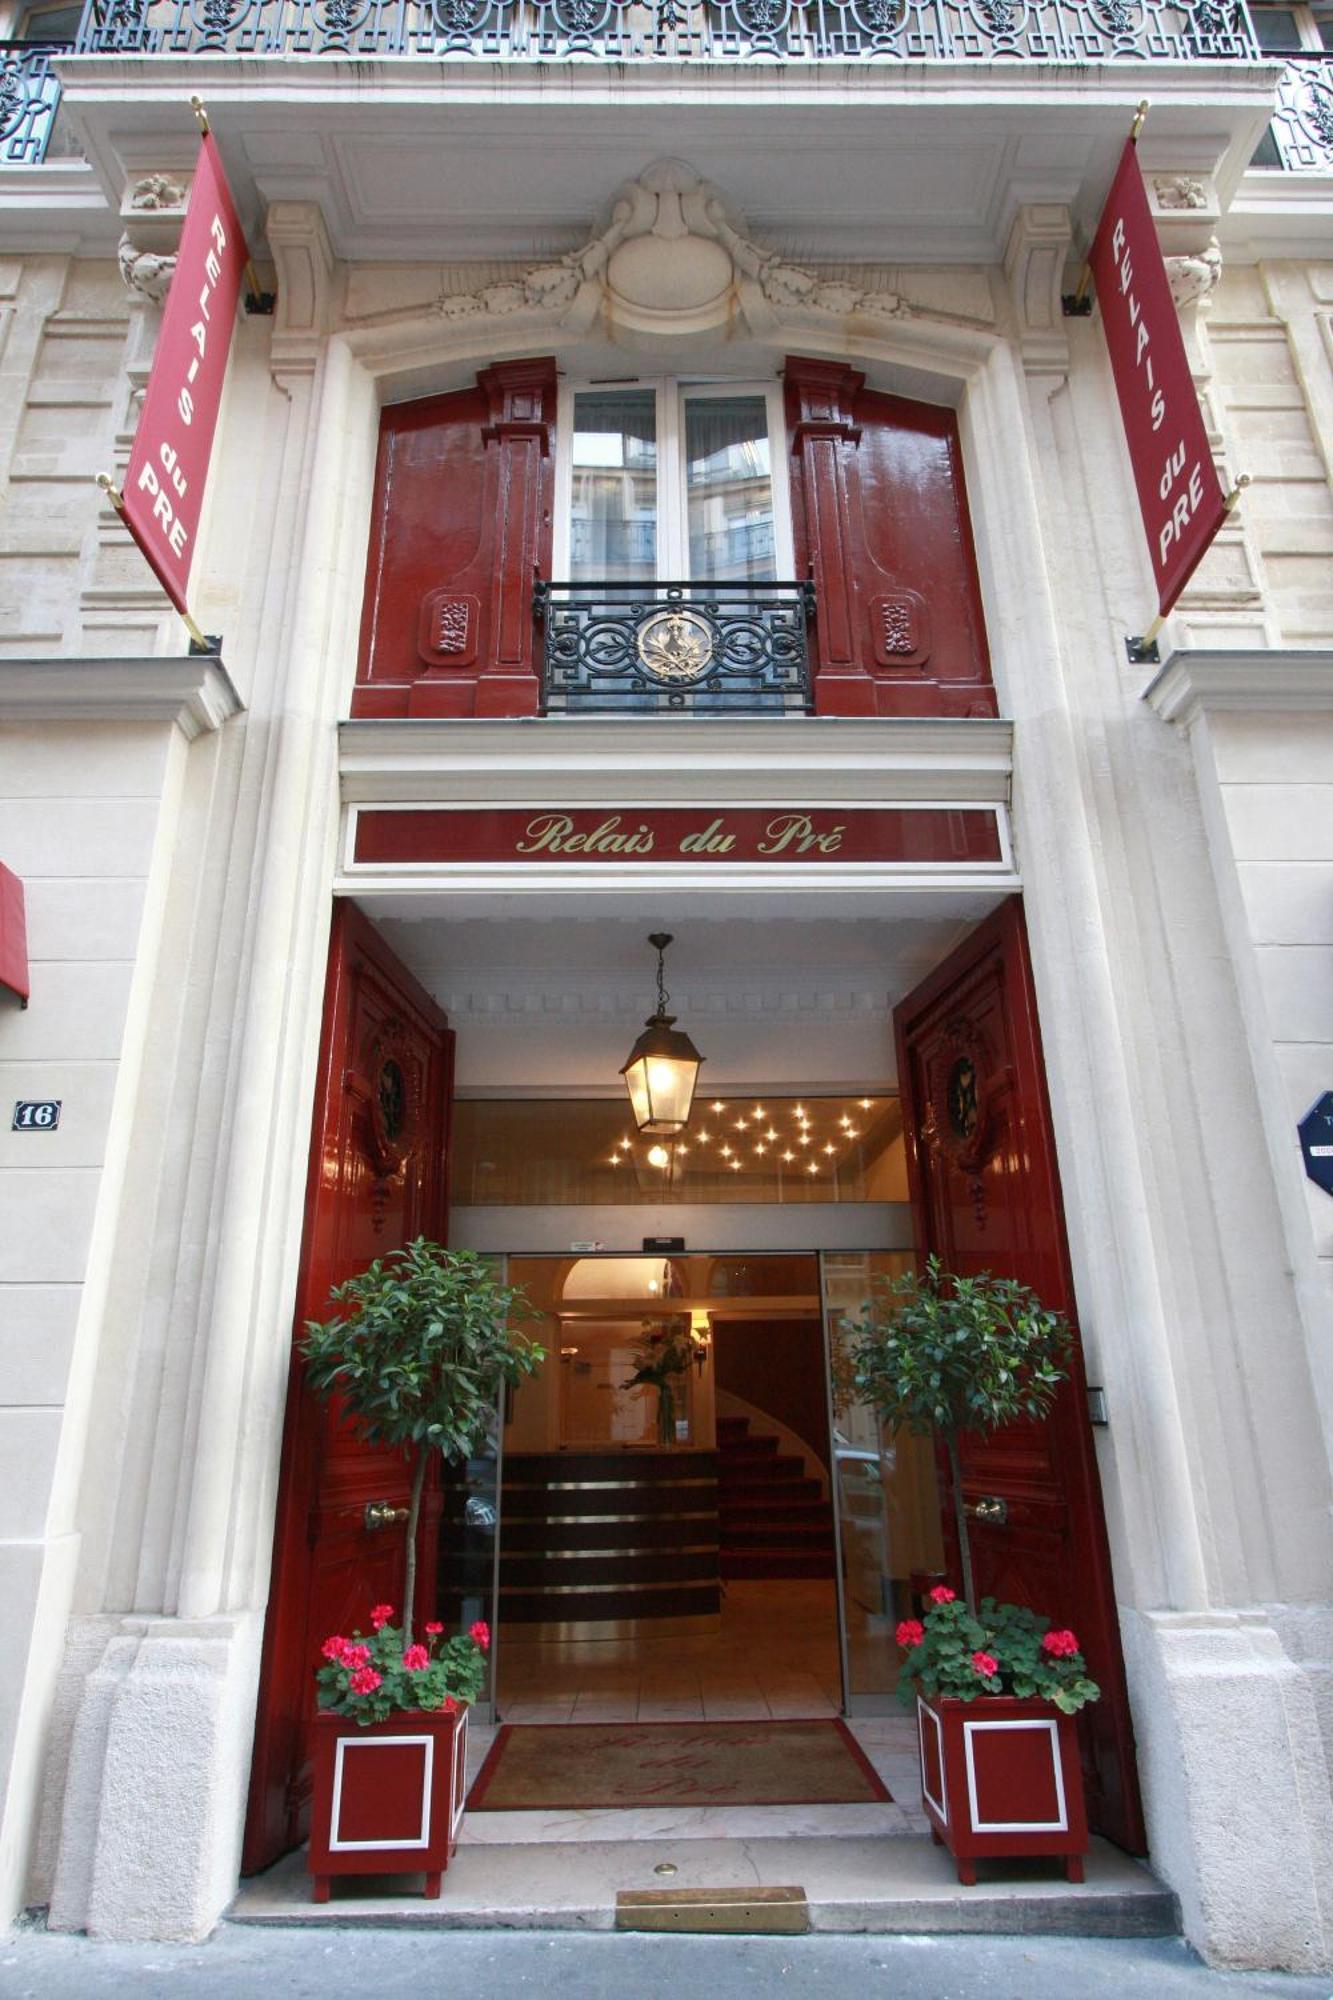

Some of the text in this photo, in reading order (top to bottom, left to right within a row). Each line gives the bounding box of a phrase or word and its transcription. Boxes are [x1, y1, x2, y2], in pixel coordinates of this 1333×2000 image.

[178, 214, 227, 427] RELAIS
[1112, 217, 1165, 432] RELAIS
[160, 442, 188, 498] du
[1160, 439, 1186, 500] du
[138, 461, 188, 559] PRE
[1160, 461, 1203, 566] PRE
[516, 814, 848, 854] Relais du Pré
[21, 1105, 53, 1125] 16
